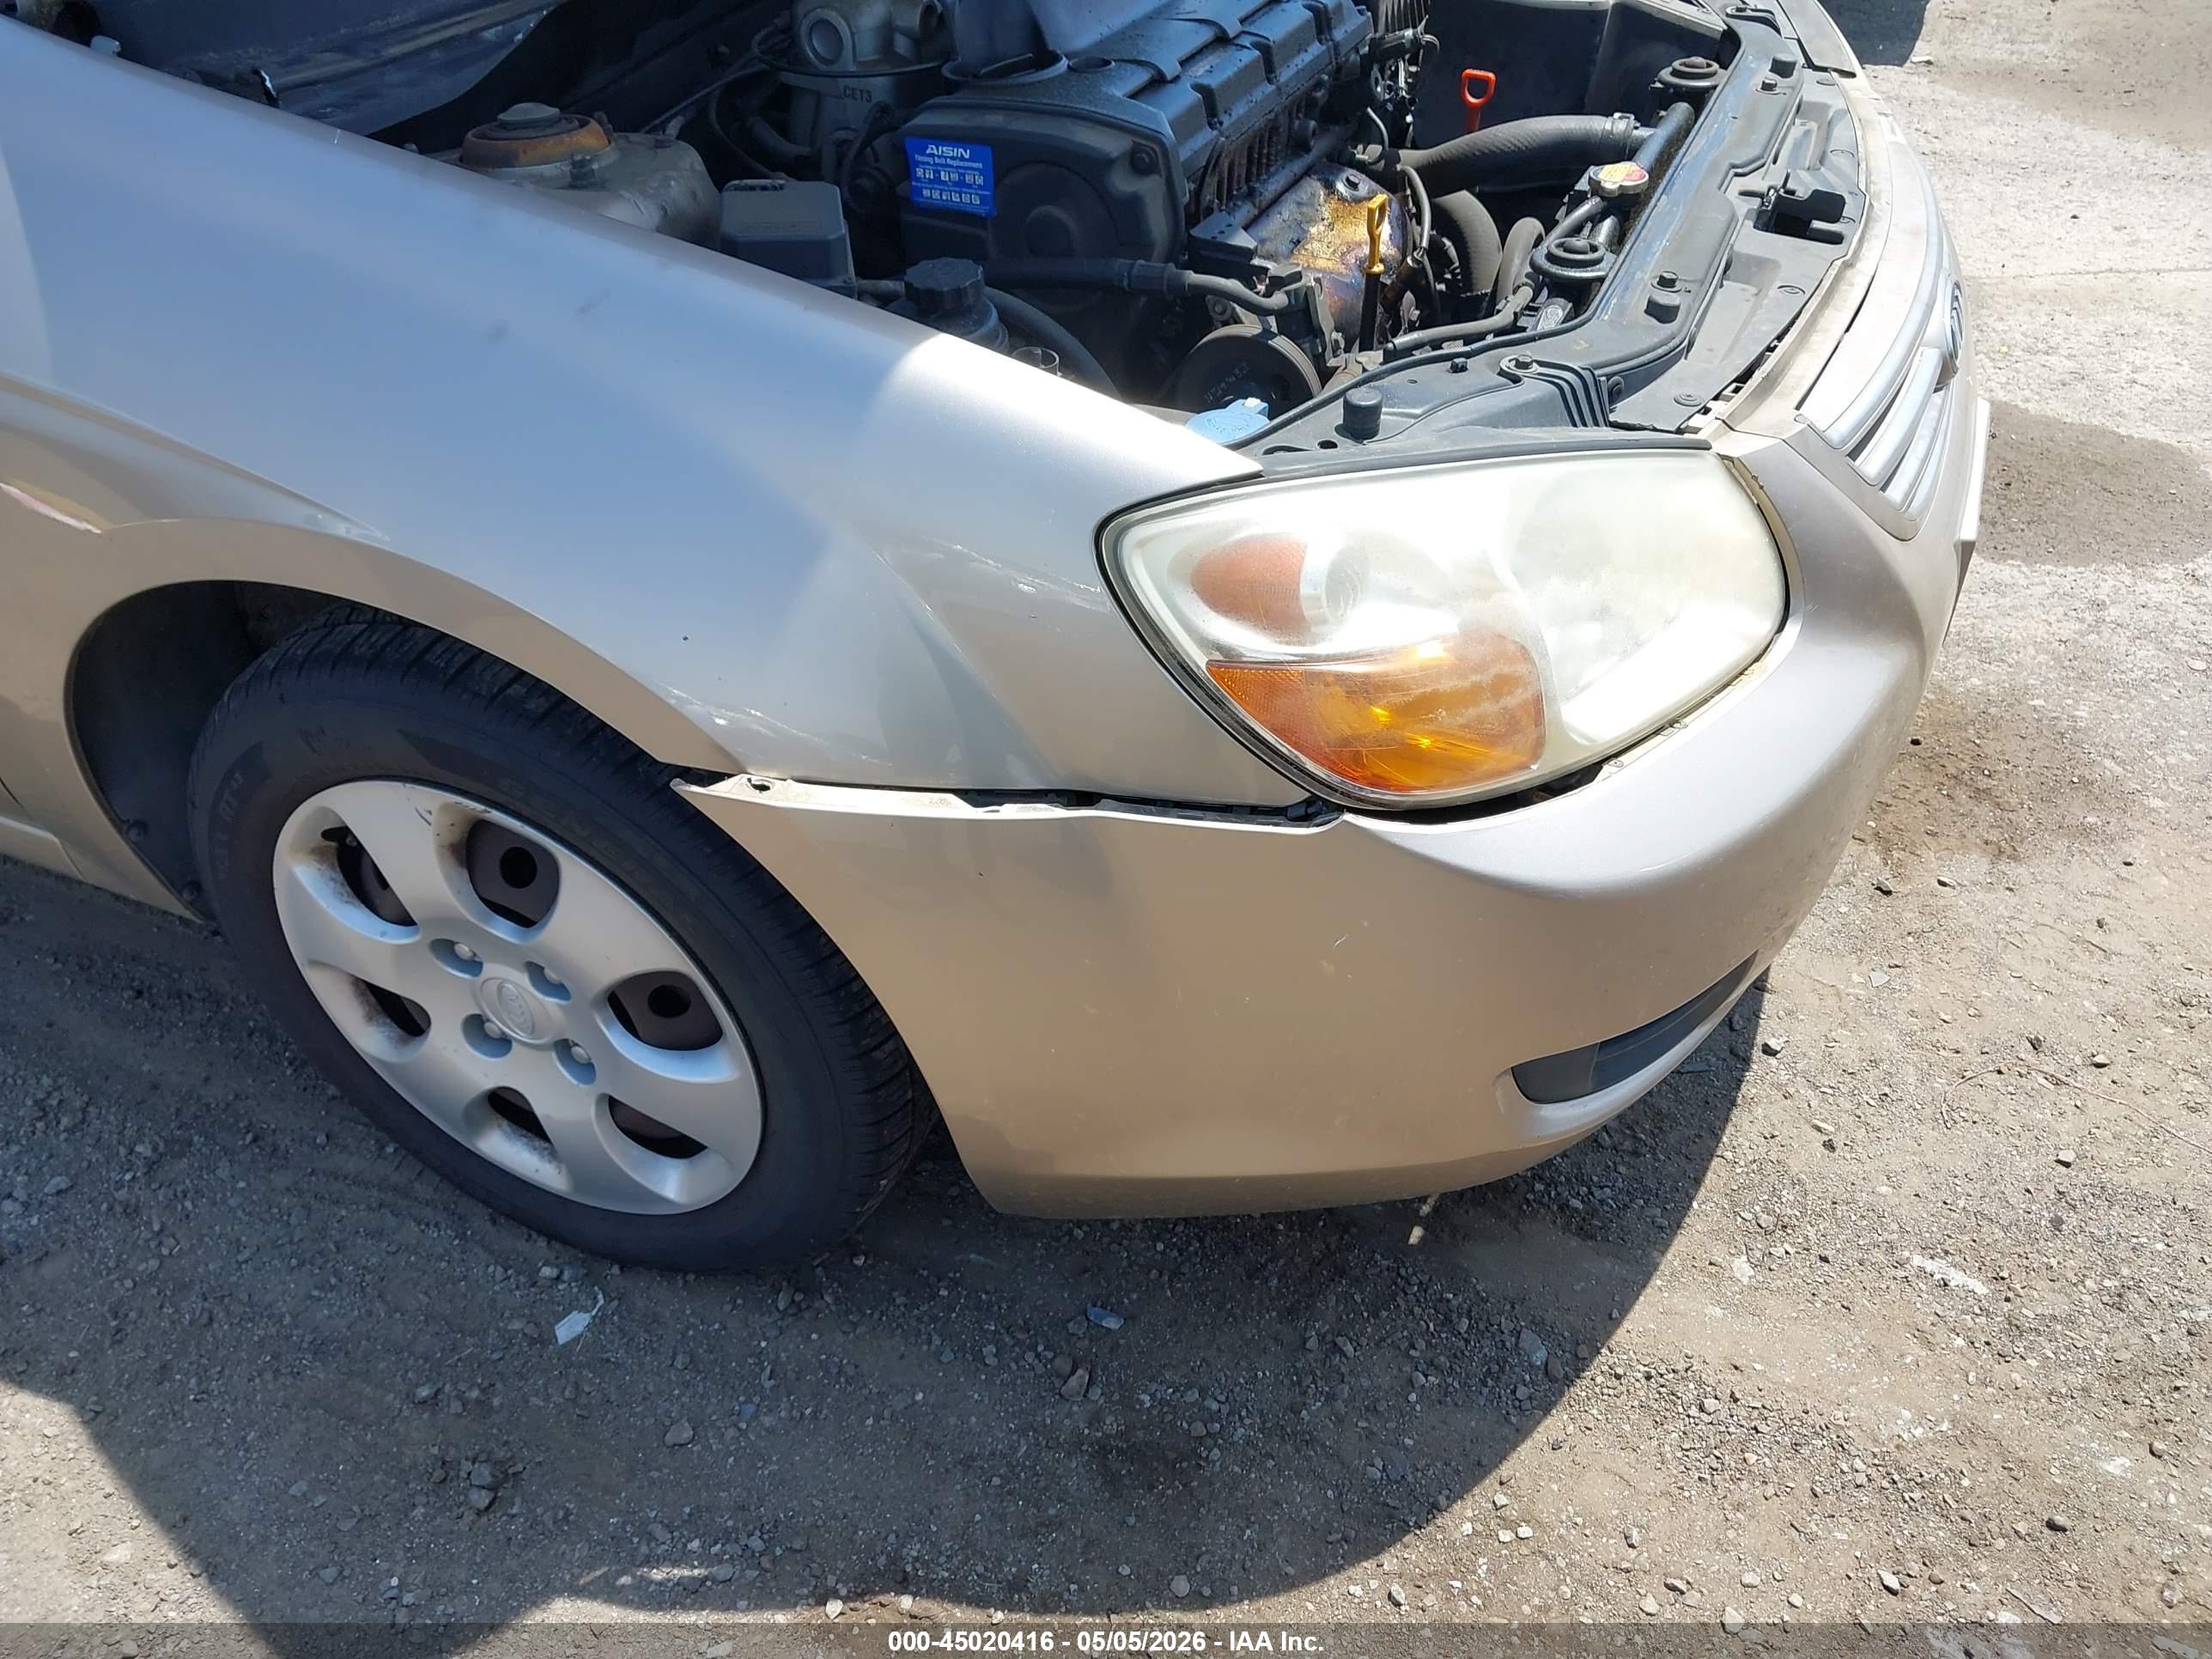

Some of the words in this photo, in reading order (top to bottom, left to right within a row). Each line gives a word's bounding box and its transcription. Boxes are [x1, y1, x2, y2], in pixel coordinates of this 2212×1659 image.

[925, 144, 970, 159] AISIN
[915, 154, 933, 165] Timing
[934, 156, 946, 165] Belt
[946, 158, 983, 169] Replacement
